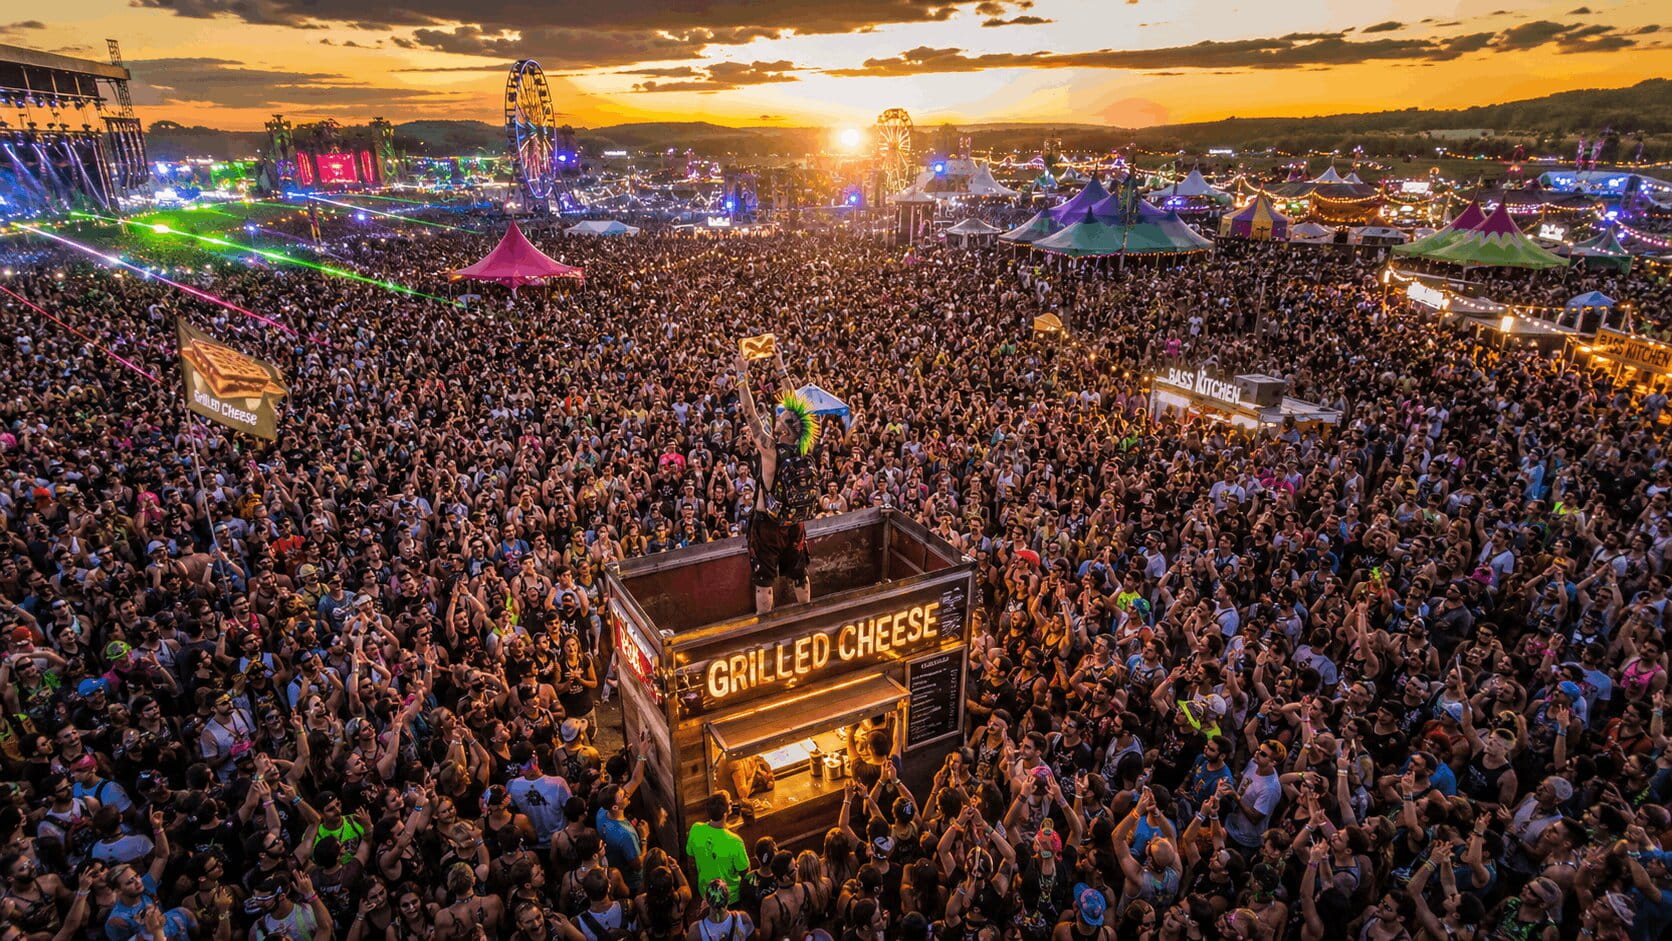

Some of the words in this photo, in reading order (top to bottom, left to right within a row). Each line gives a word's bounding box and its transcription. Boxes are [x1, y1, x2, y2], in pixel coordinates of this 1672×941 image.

[1625, 342, 1670, 367] KITCHEN
[1168, 367, 1194, 390] BASS
[1195, 369, 1241, 405] KITCHEN
[708, 632, 830, 698] GRILLED
[838, 602, 940, 661] CHEESE
